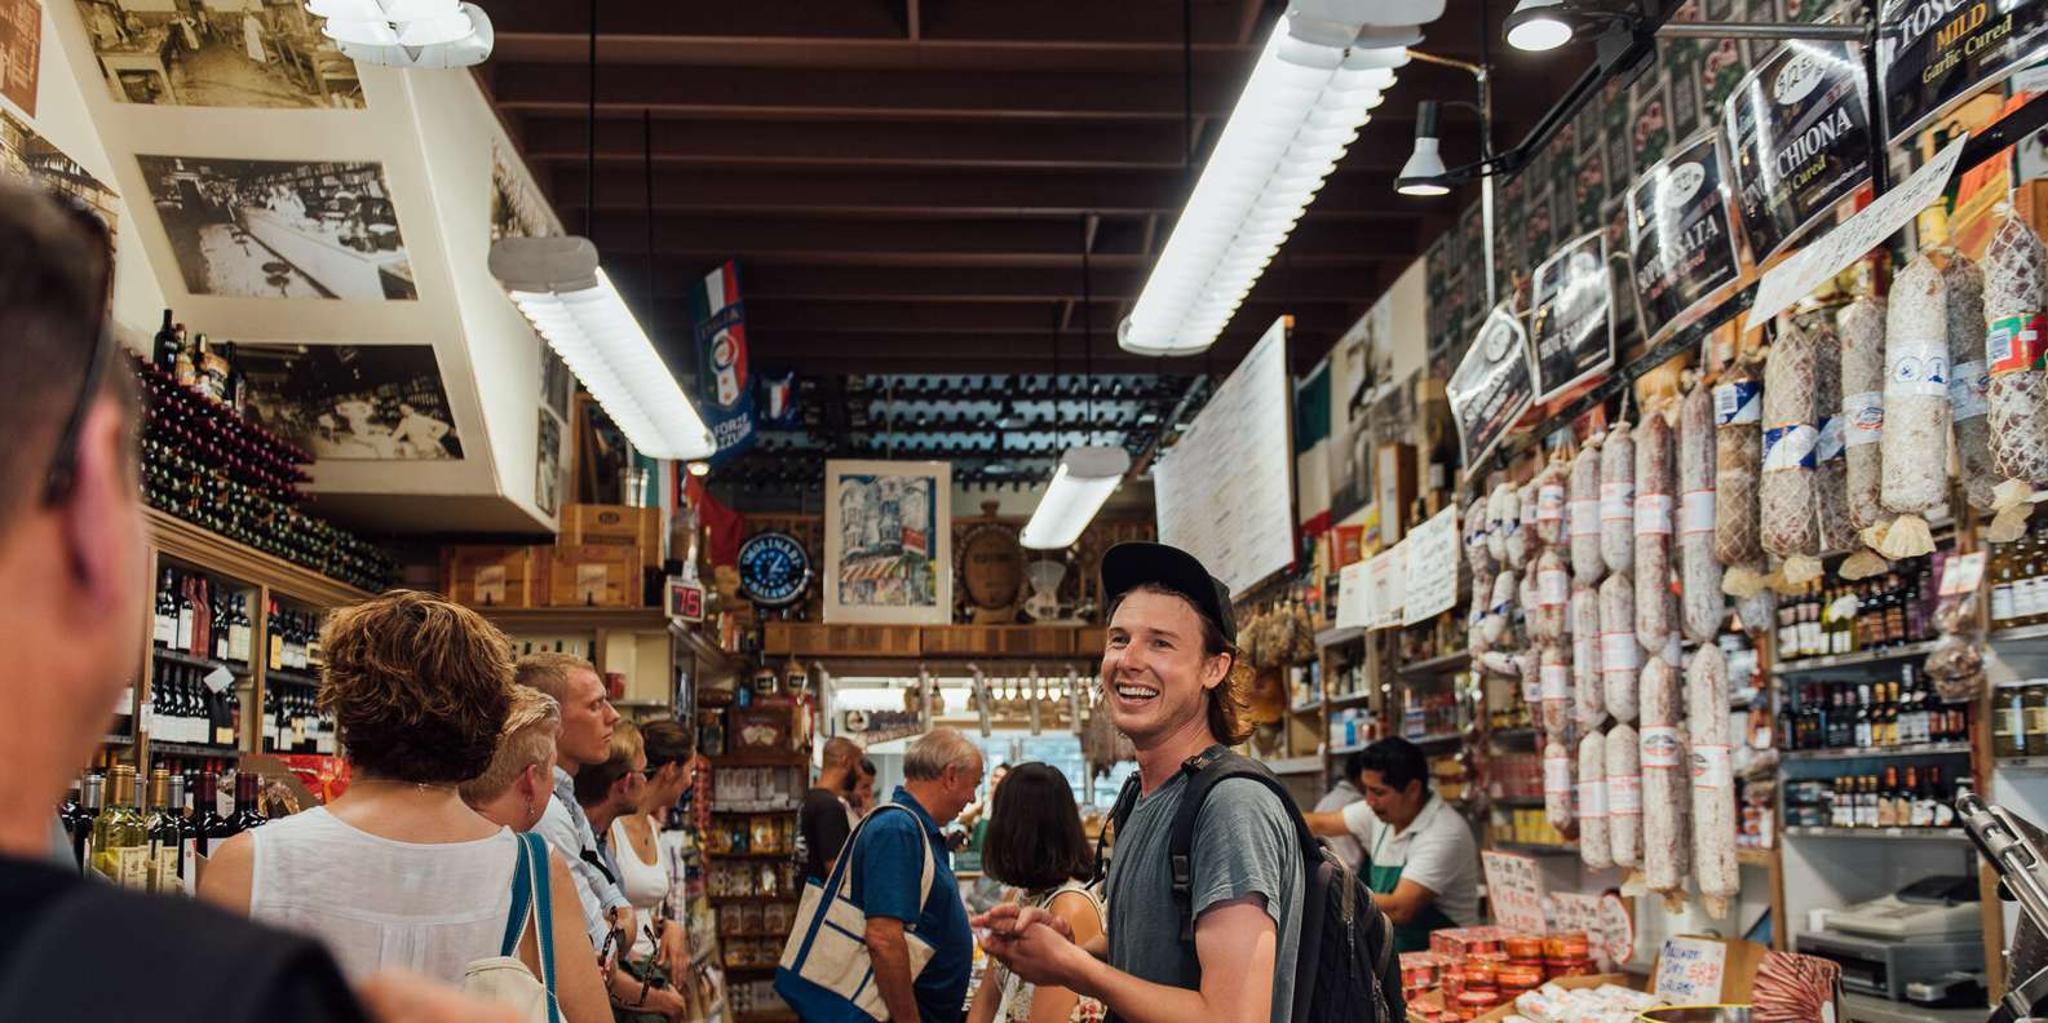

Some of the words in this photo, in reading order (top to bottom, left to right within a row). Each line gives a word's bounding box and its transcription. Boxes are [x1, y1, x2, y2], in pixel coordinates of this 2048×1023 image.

[1922, 47, 1963, 84] Garlic
[1964, 14, 2013, 55] Cured
[1936, 3, 1987, 52] MILD
[1792, 153, 1827, 189] Cured
